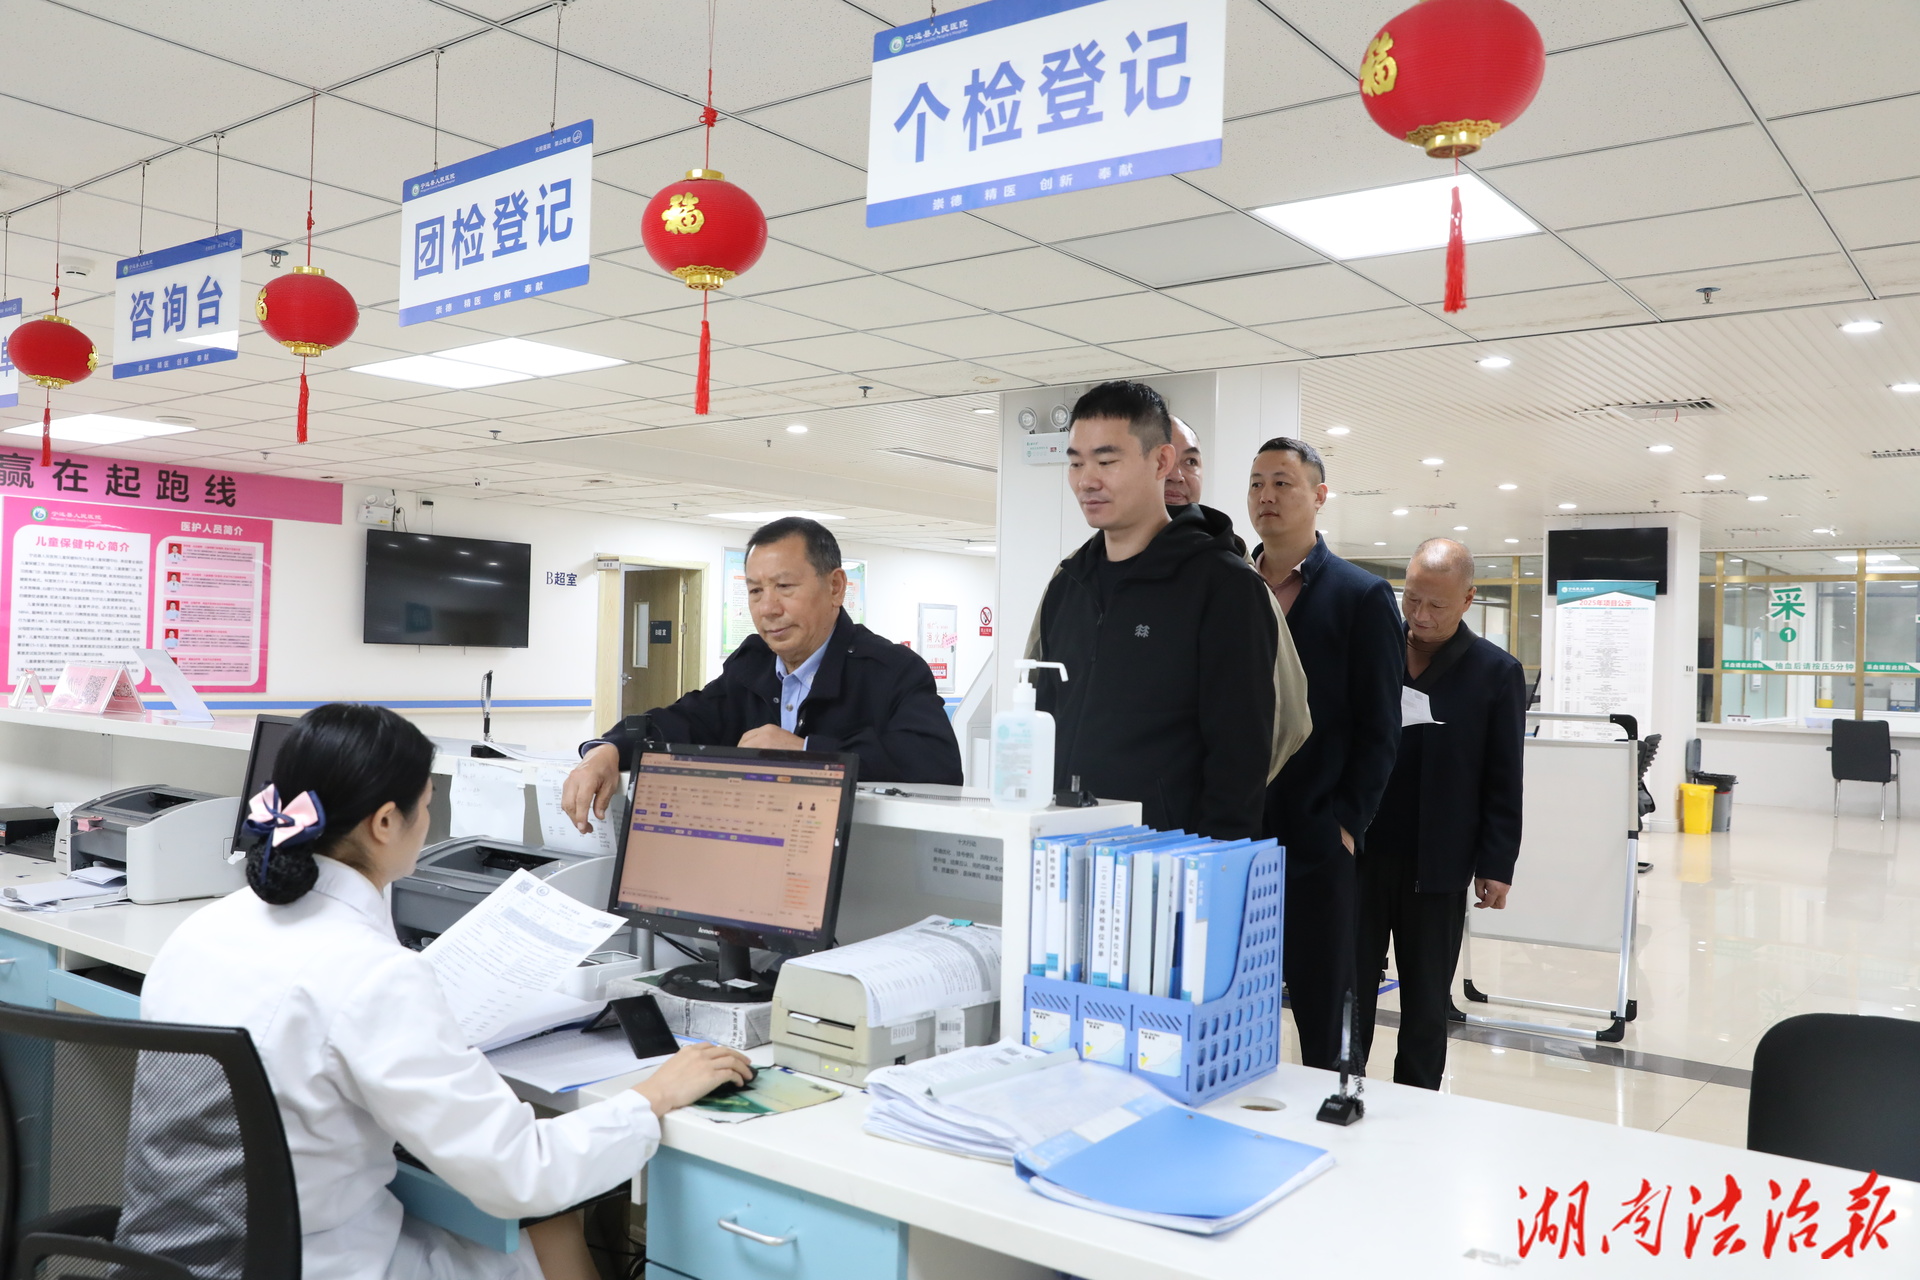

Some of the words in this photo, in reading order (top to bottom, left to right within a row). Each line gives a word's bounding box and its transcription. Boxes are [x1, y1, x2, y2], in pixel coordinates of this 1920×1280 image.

[905, 19, 968, 43] 宁远县人民医院
[893, 22, 1191, 163] 个检登记
[932, 195, 963, 211] 崇德
[984, 184, 1016, 201] 精医
[1040, 174, 1073, 191] 创新
[1098, 162, 1133, 180] 奉献
[413, 178, 573, 281] 团检登记
[130, 275, 223, 341] 咨询台
[463, 296, 482, 308] 精医
[493, 289, 512, 301] 创新
[524, 281, 543, 294] 奉献
[0, 453, 236, 507] 赢在起跑线
[181, 521, 243, 536] 医护人员简介
[36, 536, 130, 552] 儿童保健中心简介
[546, 571, 577, 587] B超室
[1579, 599, 1632, 607] 2025年项目公示
[1770, 587, 1806, 620] 采
[1775, 662, 1855, 671] 抽血后请按压5分钟
